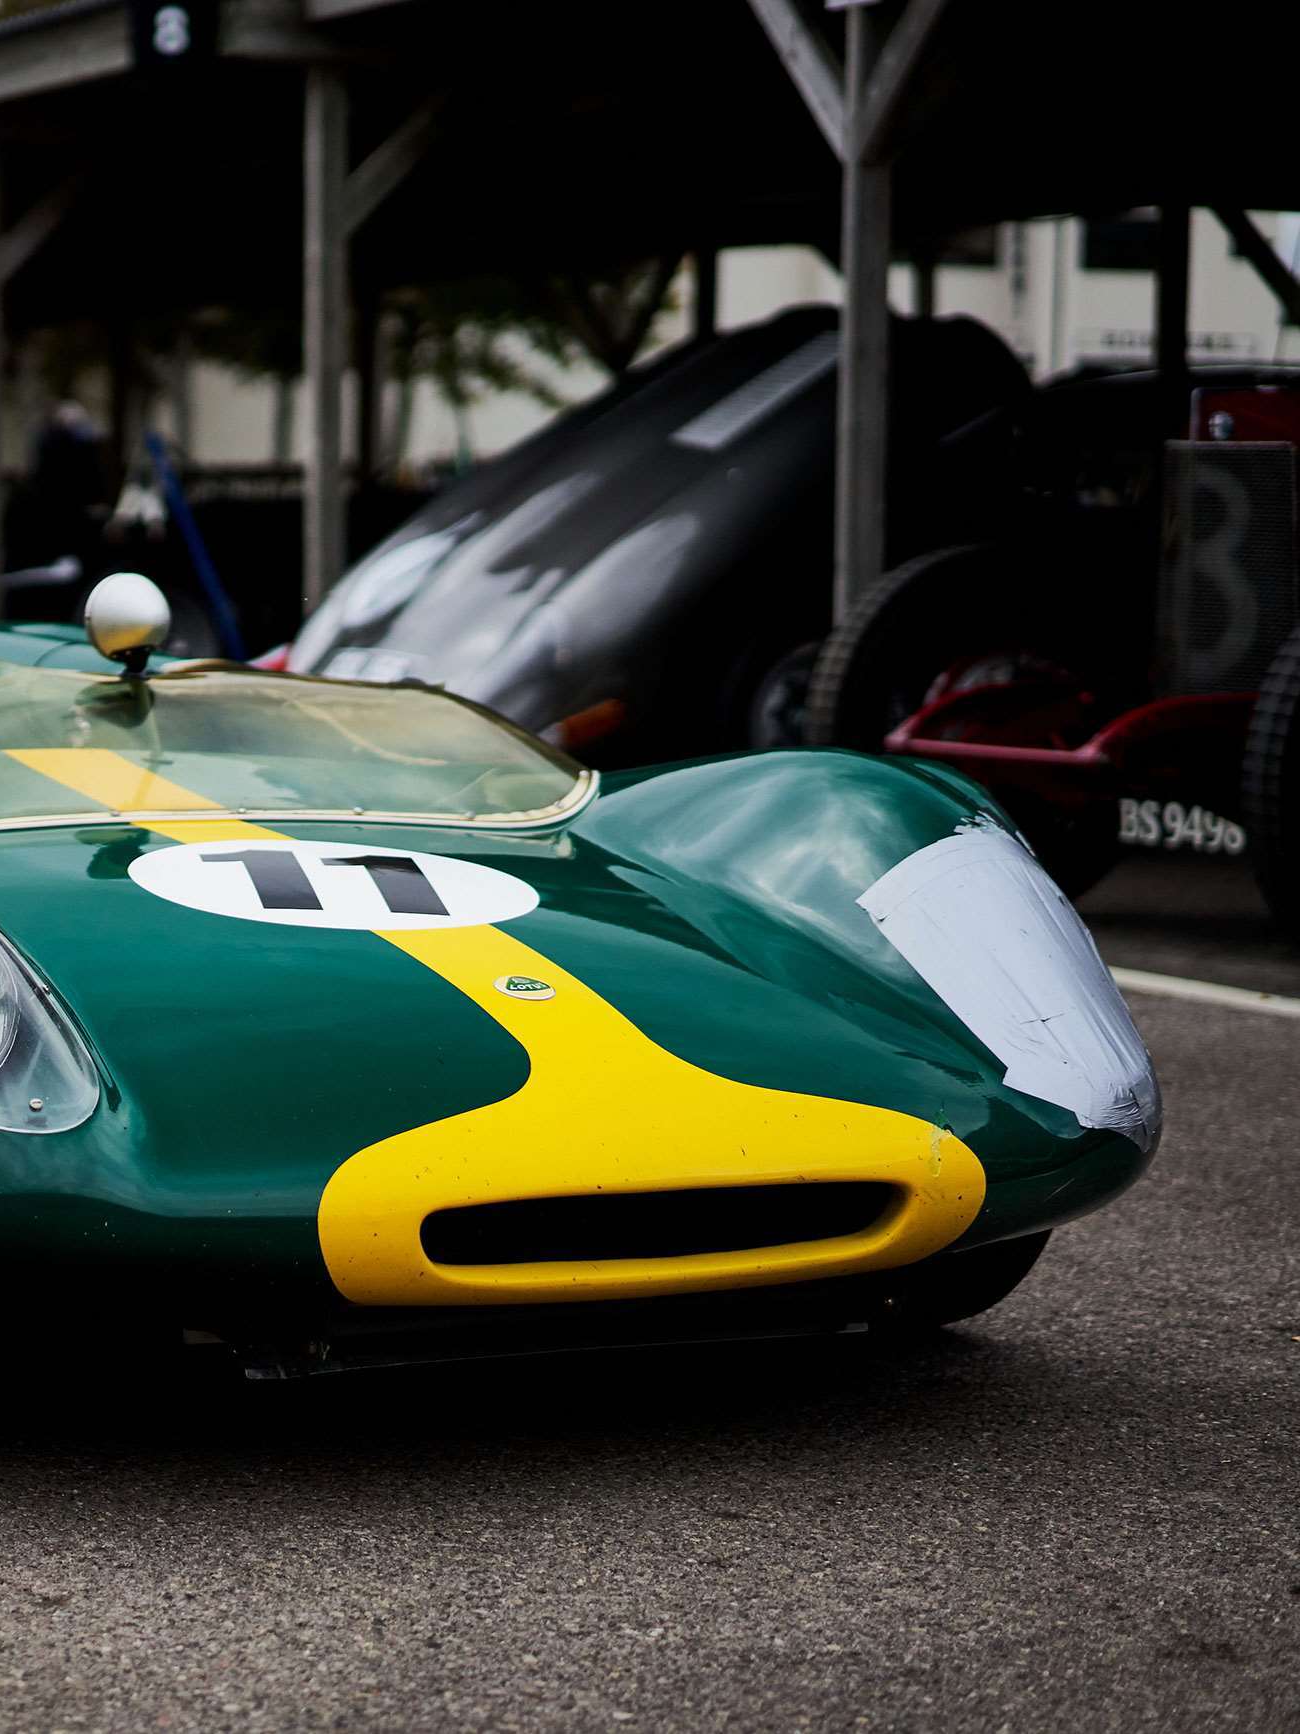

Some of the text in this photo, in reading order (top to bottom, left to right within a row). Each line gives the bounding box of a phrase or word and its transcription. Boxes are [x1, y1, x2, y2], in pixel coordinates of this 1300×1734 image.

[153, 5, 188, 56] 8
[1119, 799, 1159, 843] BS
[199, 849, 451, 916] 11
